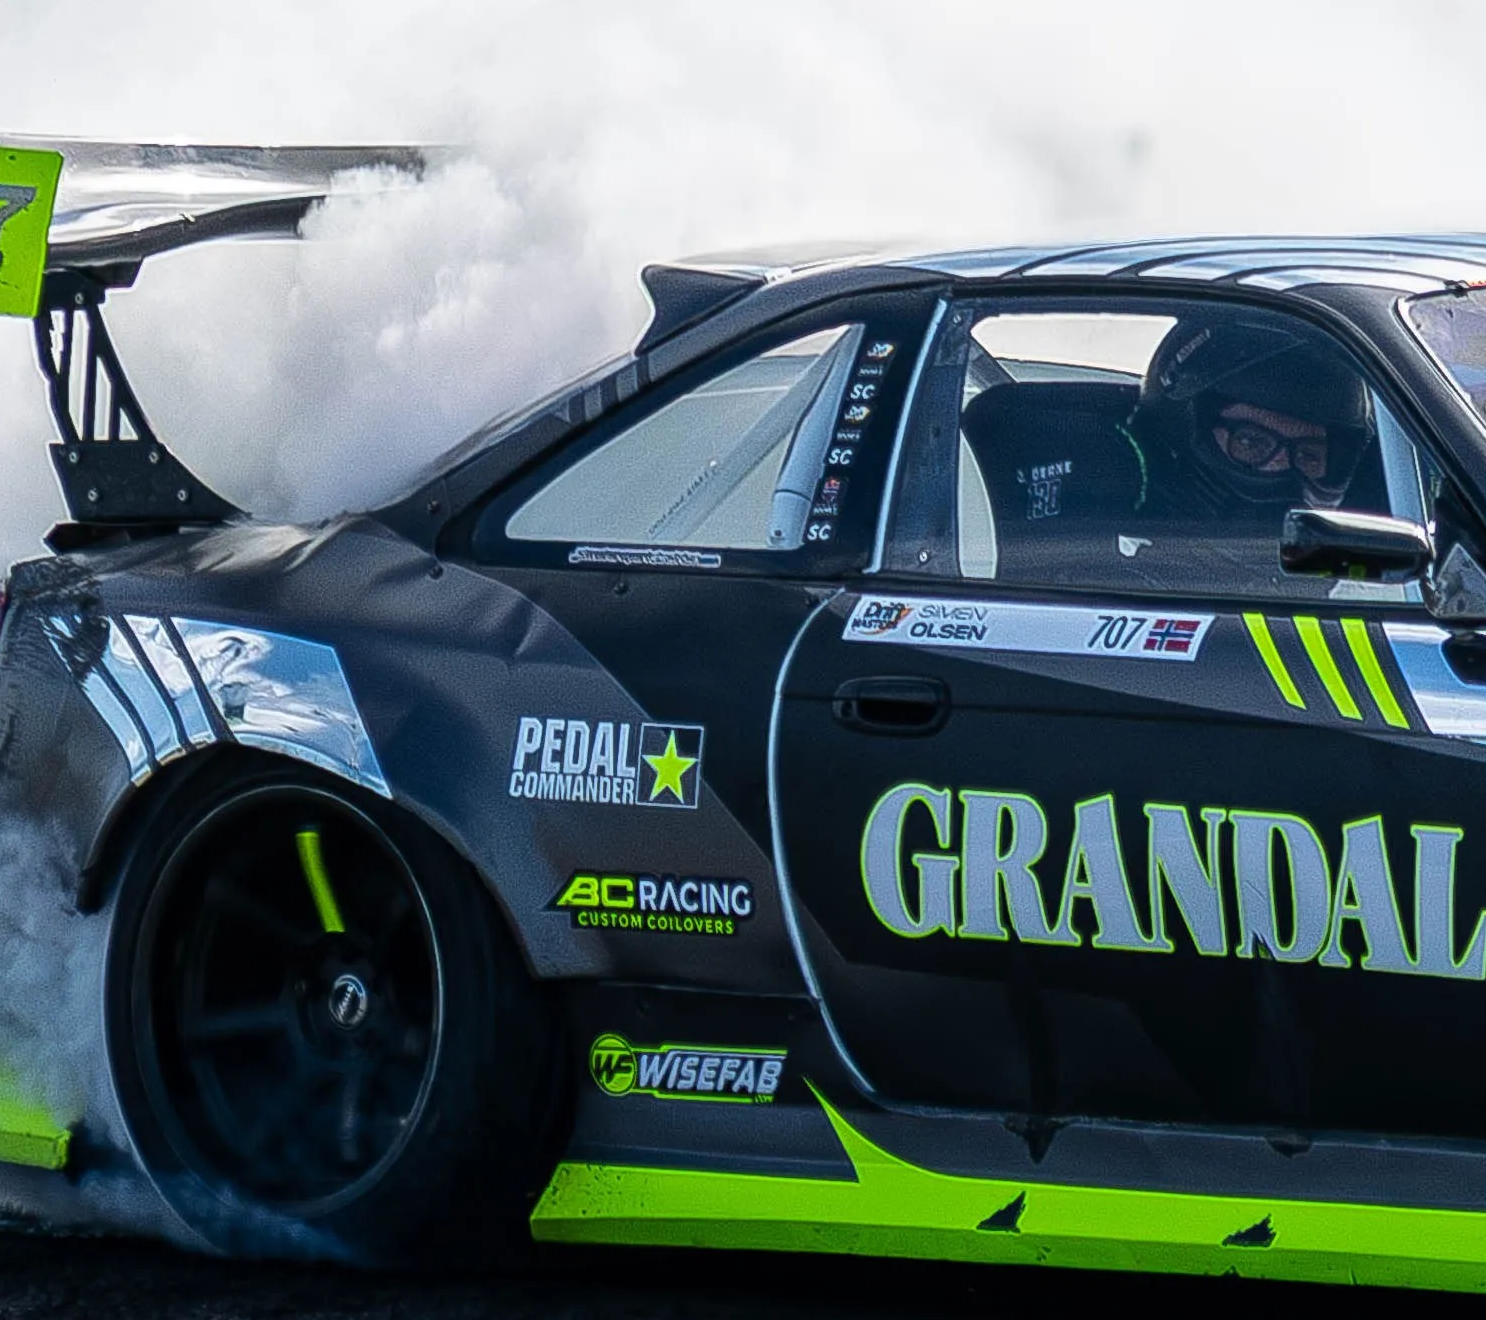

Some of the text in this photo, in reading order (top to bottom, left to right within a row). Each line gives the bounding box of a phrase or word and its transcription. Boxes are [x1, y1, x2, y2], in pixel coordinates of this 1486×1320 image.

[850, 383, 875, 400] SC
[828, 448, 853, 464] SC
[807, 524, 832, 540] SC
[910, 622, 989, 641] OLSEN
[1087, 615, 1148, 650] 707
[513, 716, 636, 778] PEDAL
[508, 771, 636, 805] COMMANDER
[557, 876, 751, 916] BC RACING
[578, 911, 735, 935] CUSTOM COILOVERS
[639, 1051, 783, 1095] WISEFAB
